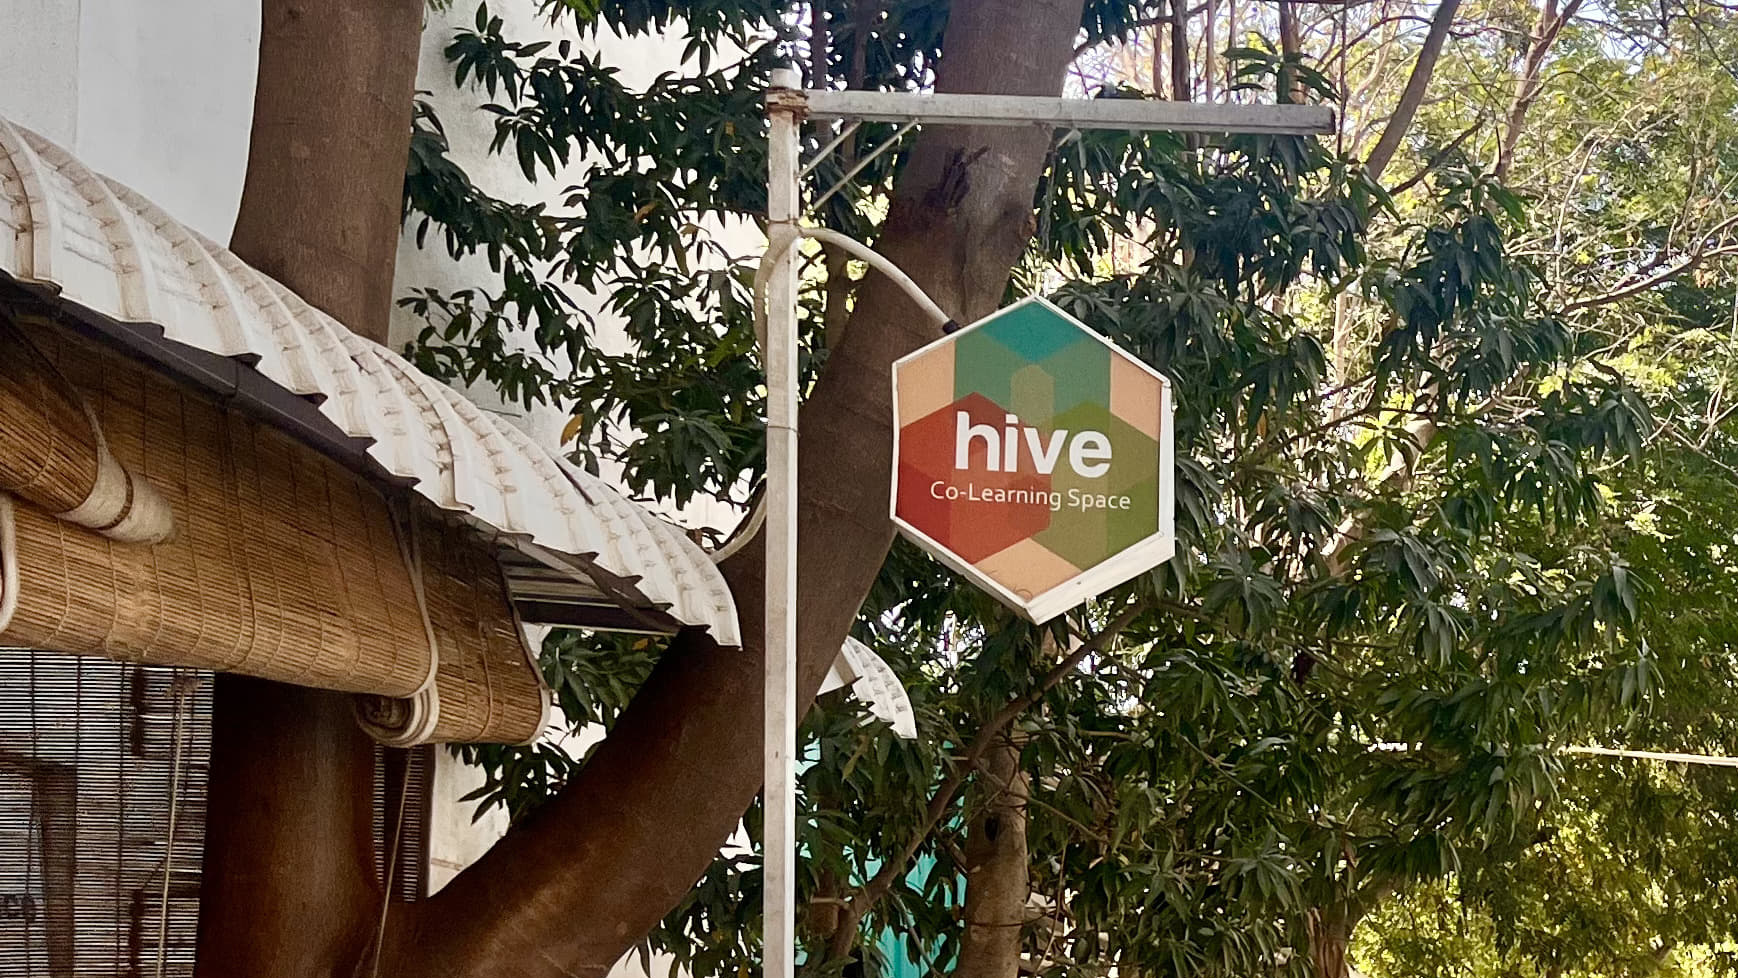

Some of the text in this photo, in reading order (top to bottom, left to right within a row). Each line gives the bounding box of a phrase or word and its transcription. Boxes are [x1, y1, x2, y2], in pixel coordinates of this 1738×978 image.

[955, 411, 1113, 478] hive
[930, 481, 1131, 512] Co-Learning Space
